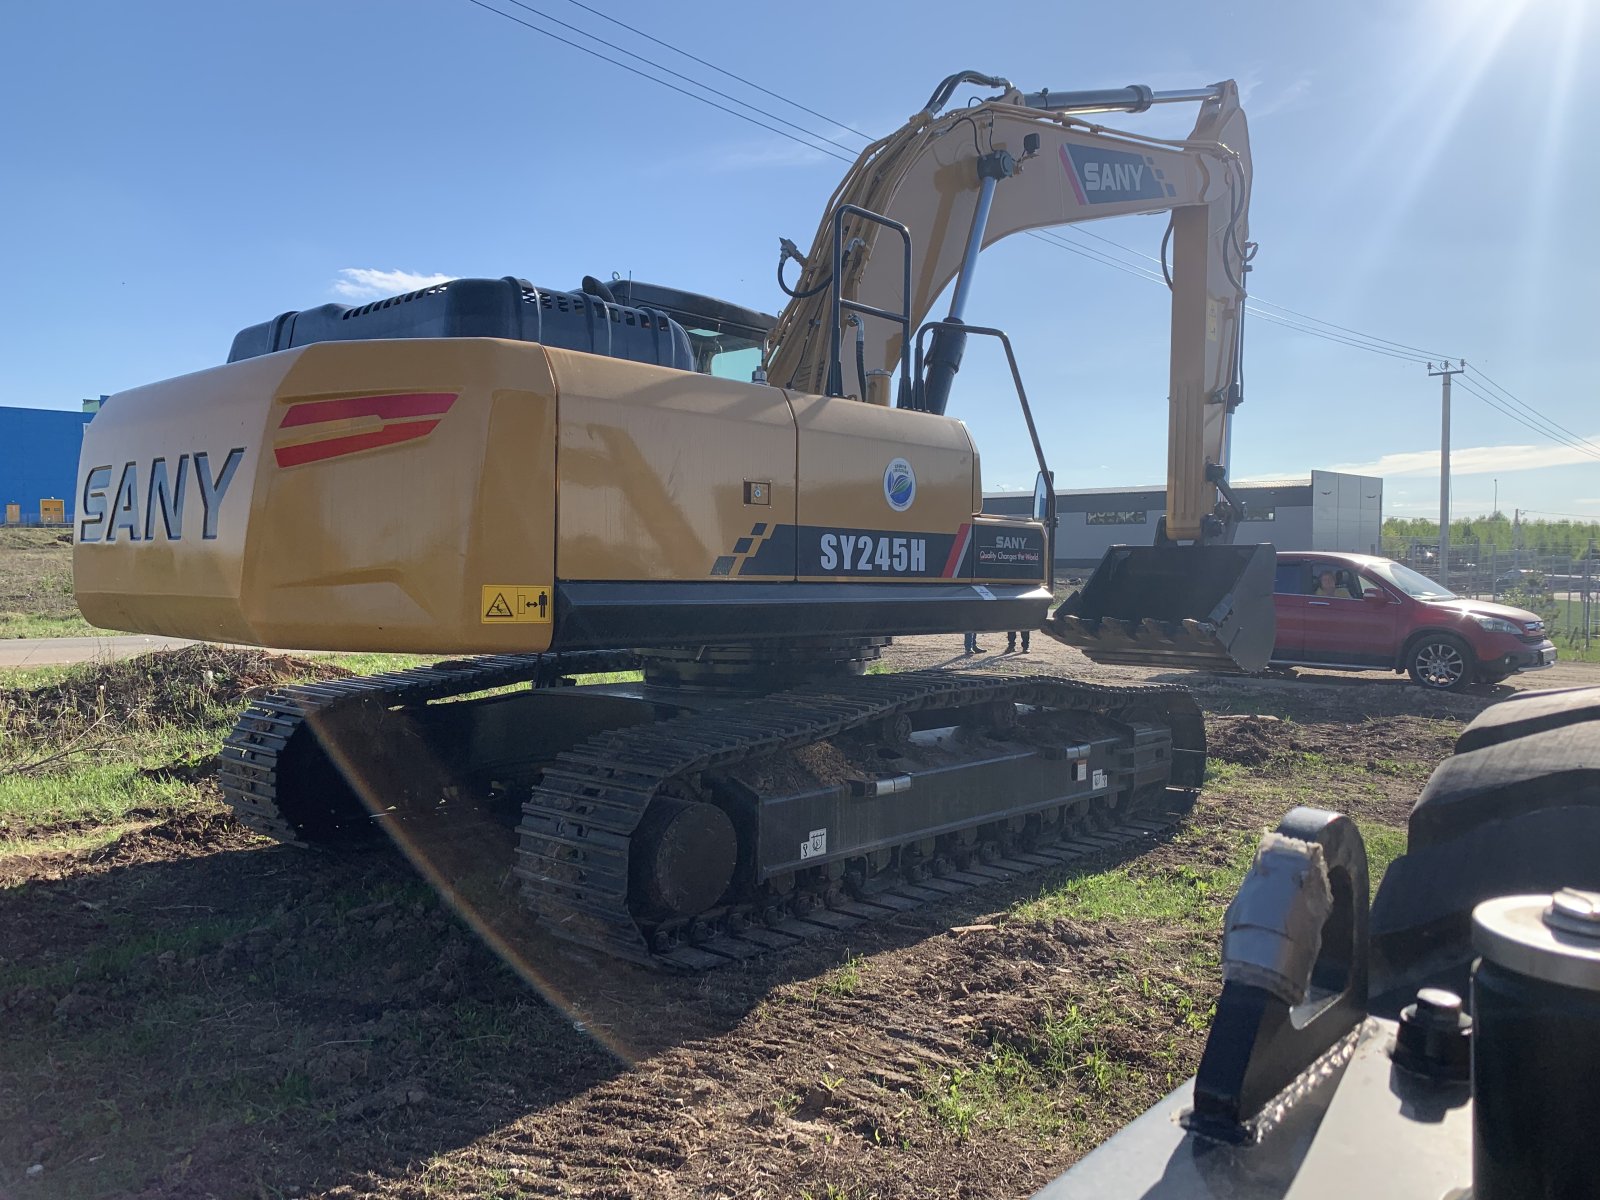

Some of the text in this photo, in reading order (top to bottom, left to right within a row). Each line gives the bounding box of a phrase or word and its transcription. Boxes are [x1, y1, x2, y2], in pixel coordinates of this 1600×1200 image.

[1084, 162, 1144, 192] SANY
[80, 446, 246, 542] SANY
[820, 533, 926, 572] SY245H
[980, 550, 1039, 562] Quality Changes the World
[995, 536, 1027, 549] SANY
